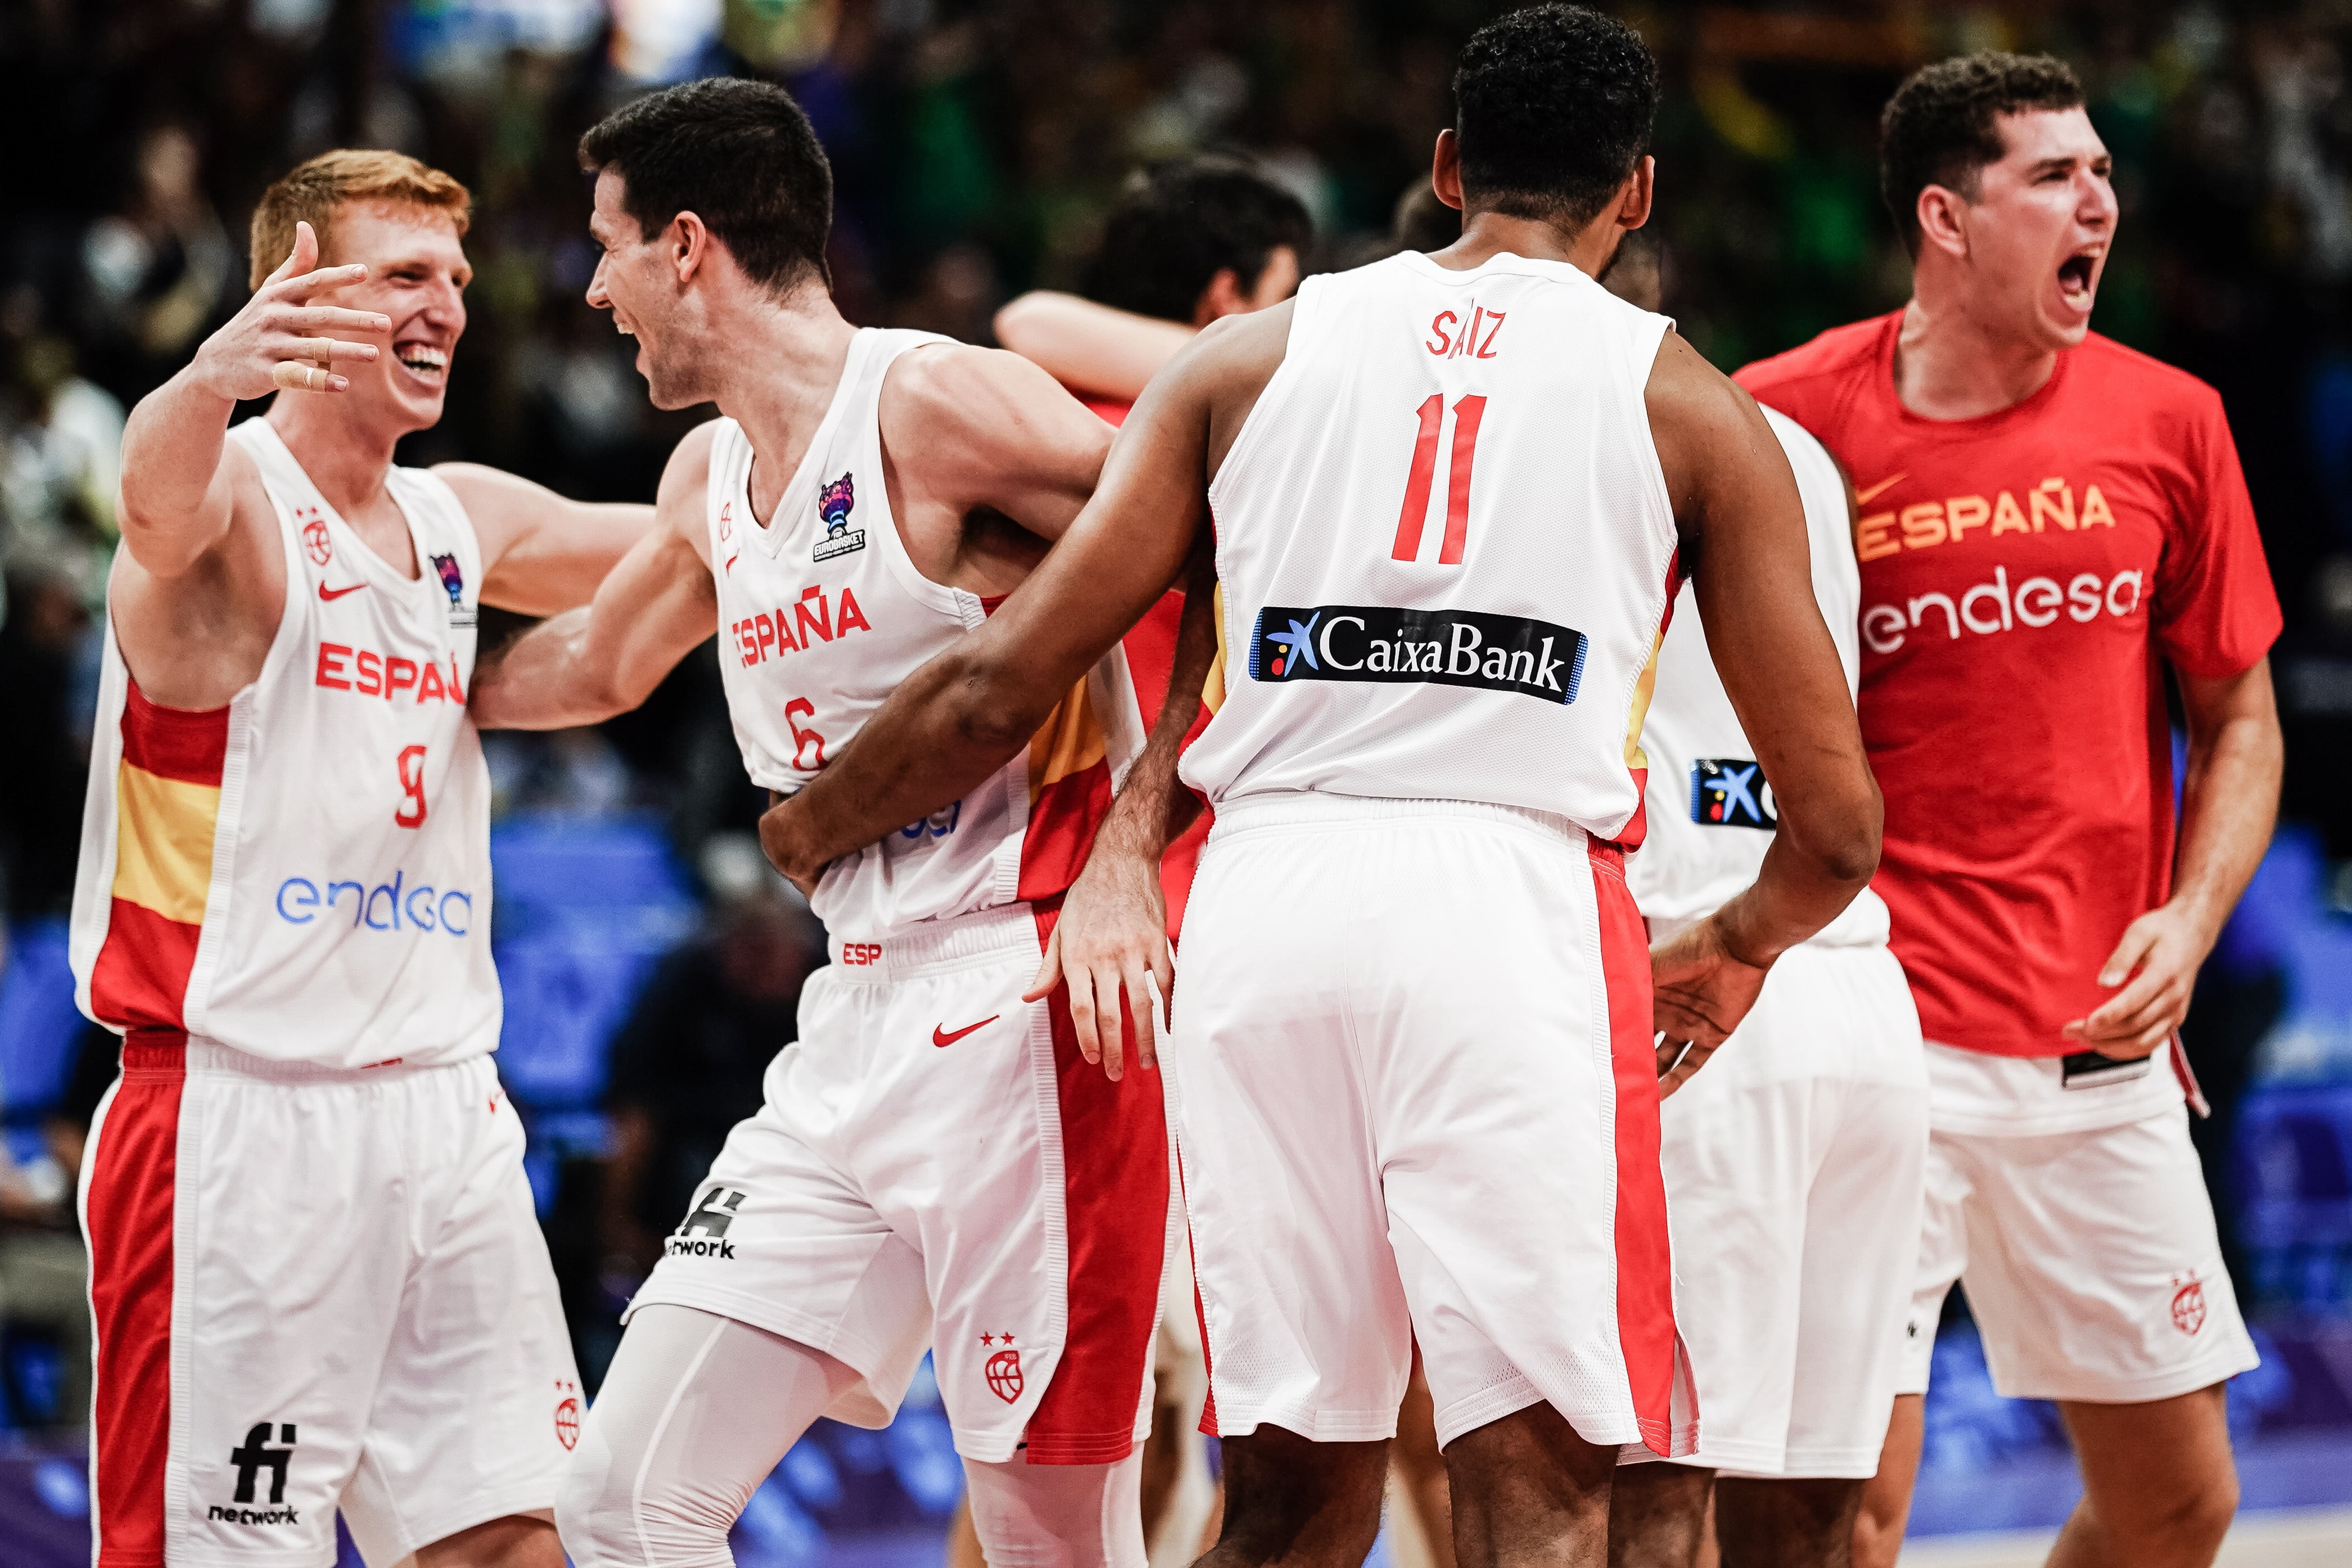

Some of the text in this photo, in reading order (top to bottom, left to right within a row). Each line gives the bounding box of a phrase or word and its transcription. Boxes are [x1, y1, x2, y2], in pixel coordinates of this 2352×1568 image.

[1391, 393, 1487, 565] 11
[1857, 477, 2116, 563] ESPAÑA
[1863, 565, 2144, 654] endesa
[316, 642, 466, 705] ESPA
[1319, 616, 1565, 693] CaixaBank
[785, 697, 830, 771] 6
[395, 745, 427, 829] 9
[843, 943, 882, 966] ESP
[230, 1422, 297, 1504] fi
